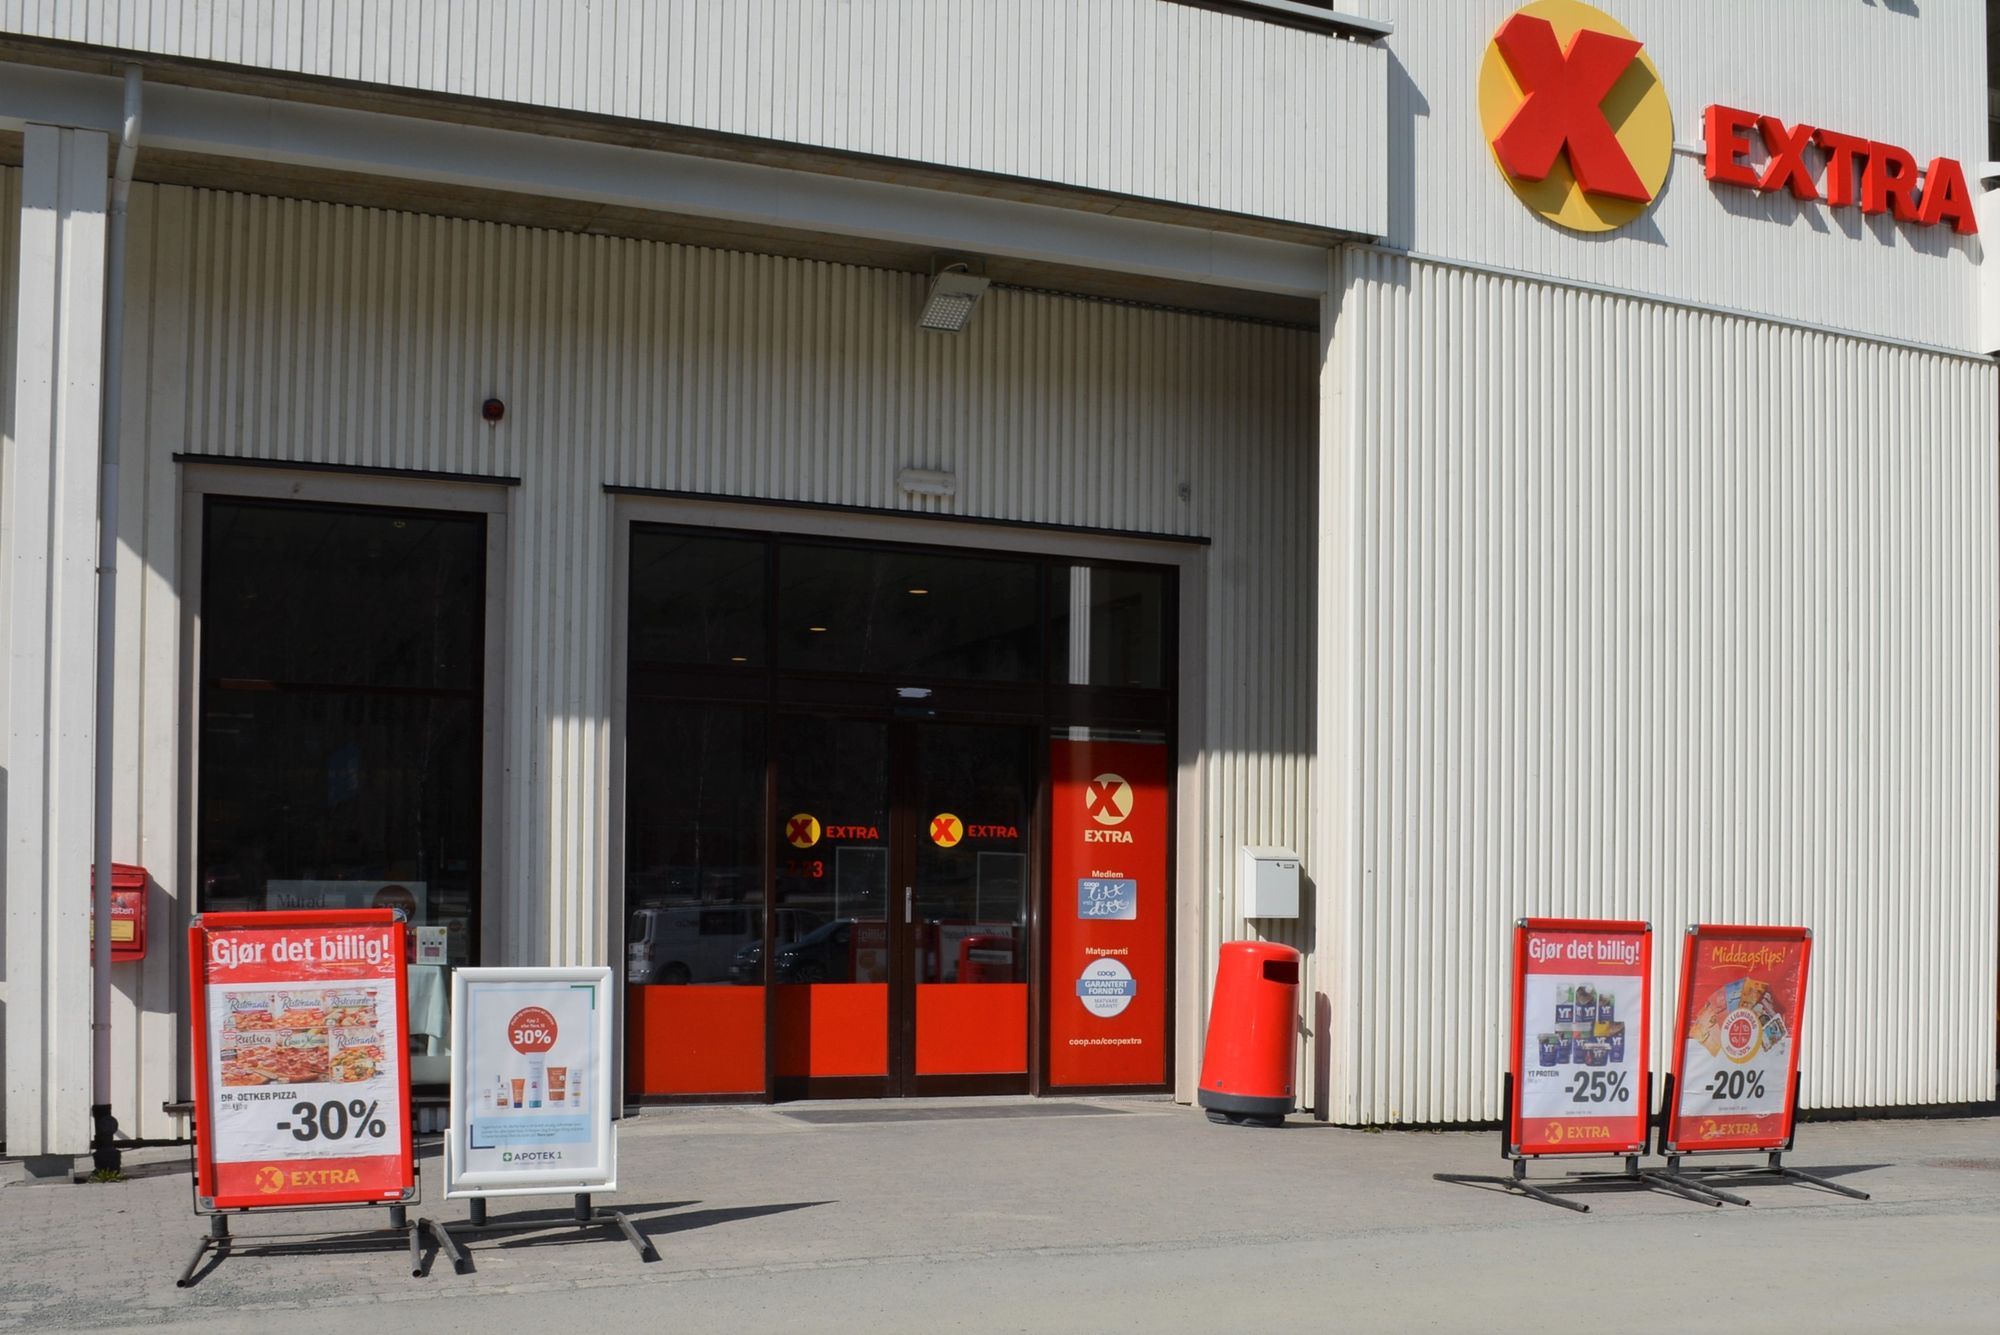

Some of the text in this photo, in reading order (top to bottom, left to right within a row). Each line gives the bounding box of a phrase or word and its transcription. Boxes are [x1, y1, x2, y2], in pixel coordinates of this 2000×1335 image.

[1704, 103, 1979, 236] EXTRA
[826, 826, 880, 840] EXTRA
[967, 825, 1019, 838] EXTRA
[1085, 829, 1134, 843] EXTRA
[1091, 870, 1124, 879] Medlem
[212, 934, 390, 969] Gjør det billig!
[1085, 947, 1129, 957] Matgaranti
[1528, 938, 1640, 965] Gjør det billig!
[1711, 945, 1786, 971] Middagstips!
[1084, 980, 1128, 988] GARANTERT
[1088, 987, 1124, 995] FORNØYD
[513, 1029, 552, 1045] 30%
[1068, 1038, 1142, 1047] coop.no/coopextra
[1536, 1070, 1560, 1078] PROTEIN
[1564, 1070, 1630, 1103] -25%
[1705, 1070, 1766, 1100] -20%
[237, 1092, 271, 1101] OETKER
[273, 1091, 297, 1100] PIZZA
[277, 1099, 387, 1142] -30%
[1567, 1125, 1610, 1139] EXTRA
[1719, 1123, 1759, 1137] EXTRA
[514, 1150, 562, 1161] APOTEK 1
[291, 1169, 360, 1187] EXTRA
